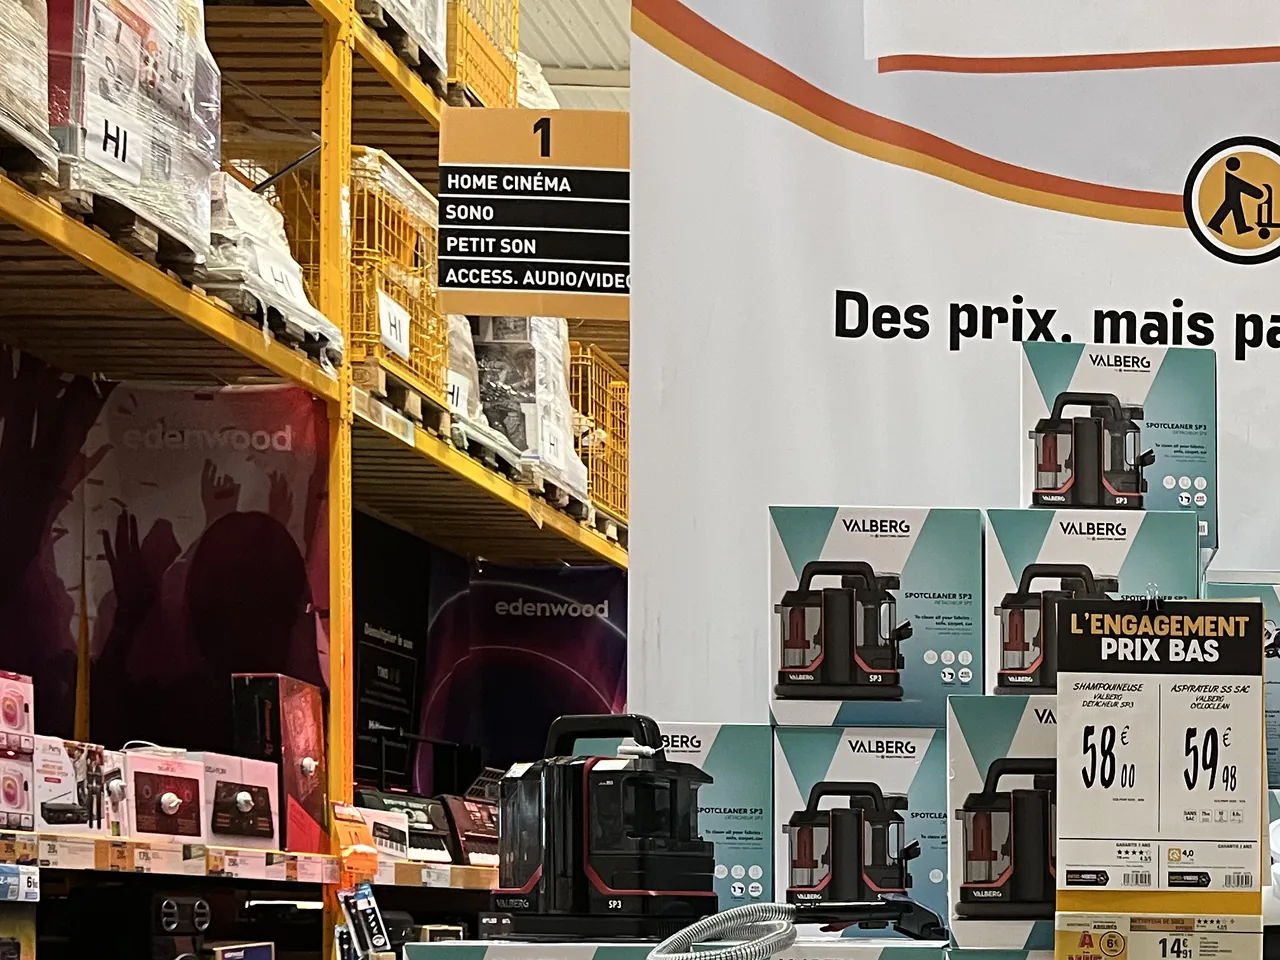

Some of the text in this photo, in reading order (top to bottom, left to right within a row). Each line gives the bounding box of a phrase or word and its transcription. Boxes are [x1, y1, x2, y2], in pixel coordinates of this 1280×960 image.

[533, 117, 551, 158] 1
[447, 172, 572, 192] HOME CINÉMA
[445, 204, 494, 220] SONO
[446, 236, 536, 254] PETIT SON
[445, 268, 519, 285] ACCESS.
[835, 289, 929, 343] Des
[1094, 298, 1215, 346] mais
[1088, 354, 1151, 369] VALBERG
[1145, 422, 1193, 431] SPOTCLEANER
[123, 424, 292, 452] edenwood
[842, 519, 910, 533] VALBERG
[1059, 521, 1127, 536] VALBERG
[904, 592, 957, 600] SPOTCLEANER
[495, 598, 608, 618] edenwood
[1070, 613, 1249, 637] L'ENGAGEMENT
[1101, 637, 1220, 662] PRIX BAS
[869, 674, 882, 682] SP3
[1073, 682, 1144, 692] SHAMPOUINEUSE
[1220, 685, 1233, 694] SS
[1233, 685, 1251, 694] SAC
[1093, 693, 1123, 701] VALBERG
[662, 735, 702, 749] BERG
[848, 740, 917, 754] VALBERG
[749, 807, 764, 815] SP3
[608, 900, 622, 909] SP3
